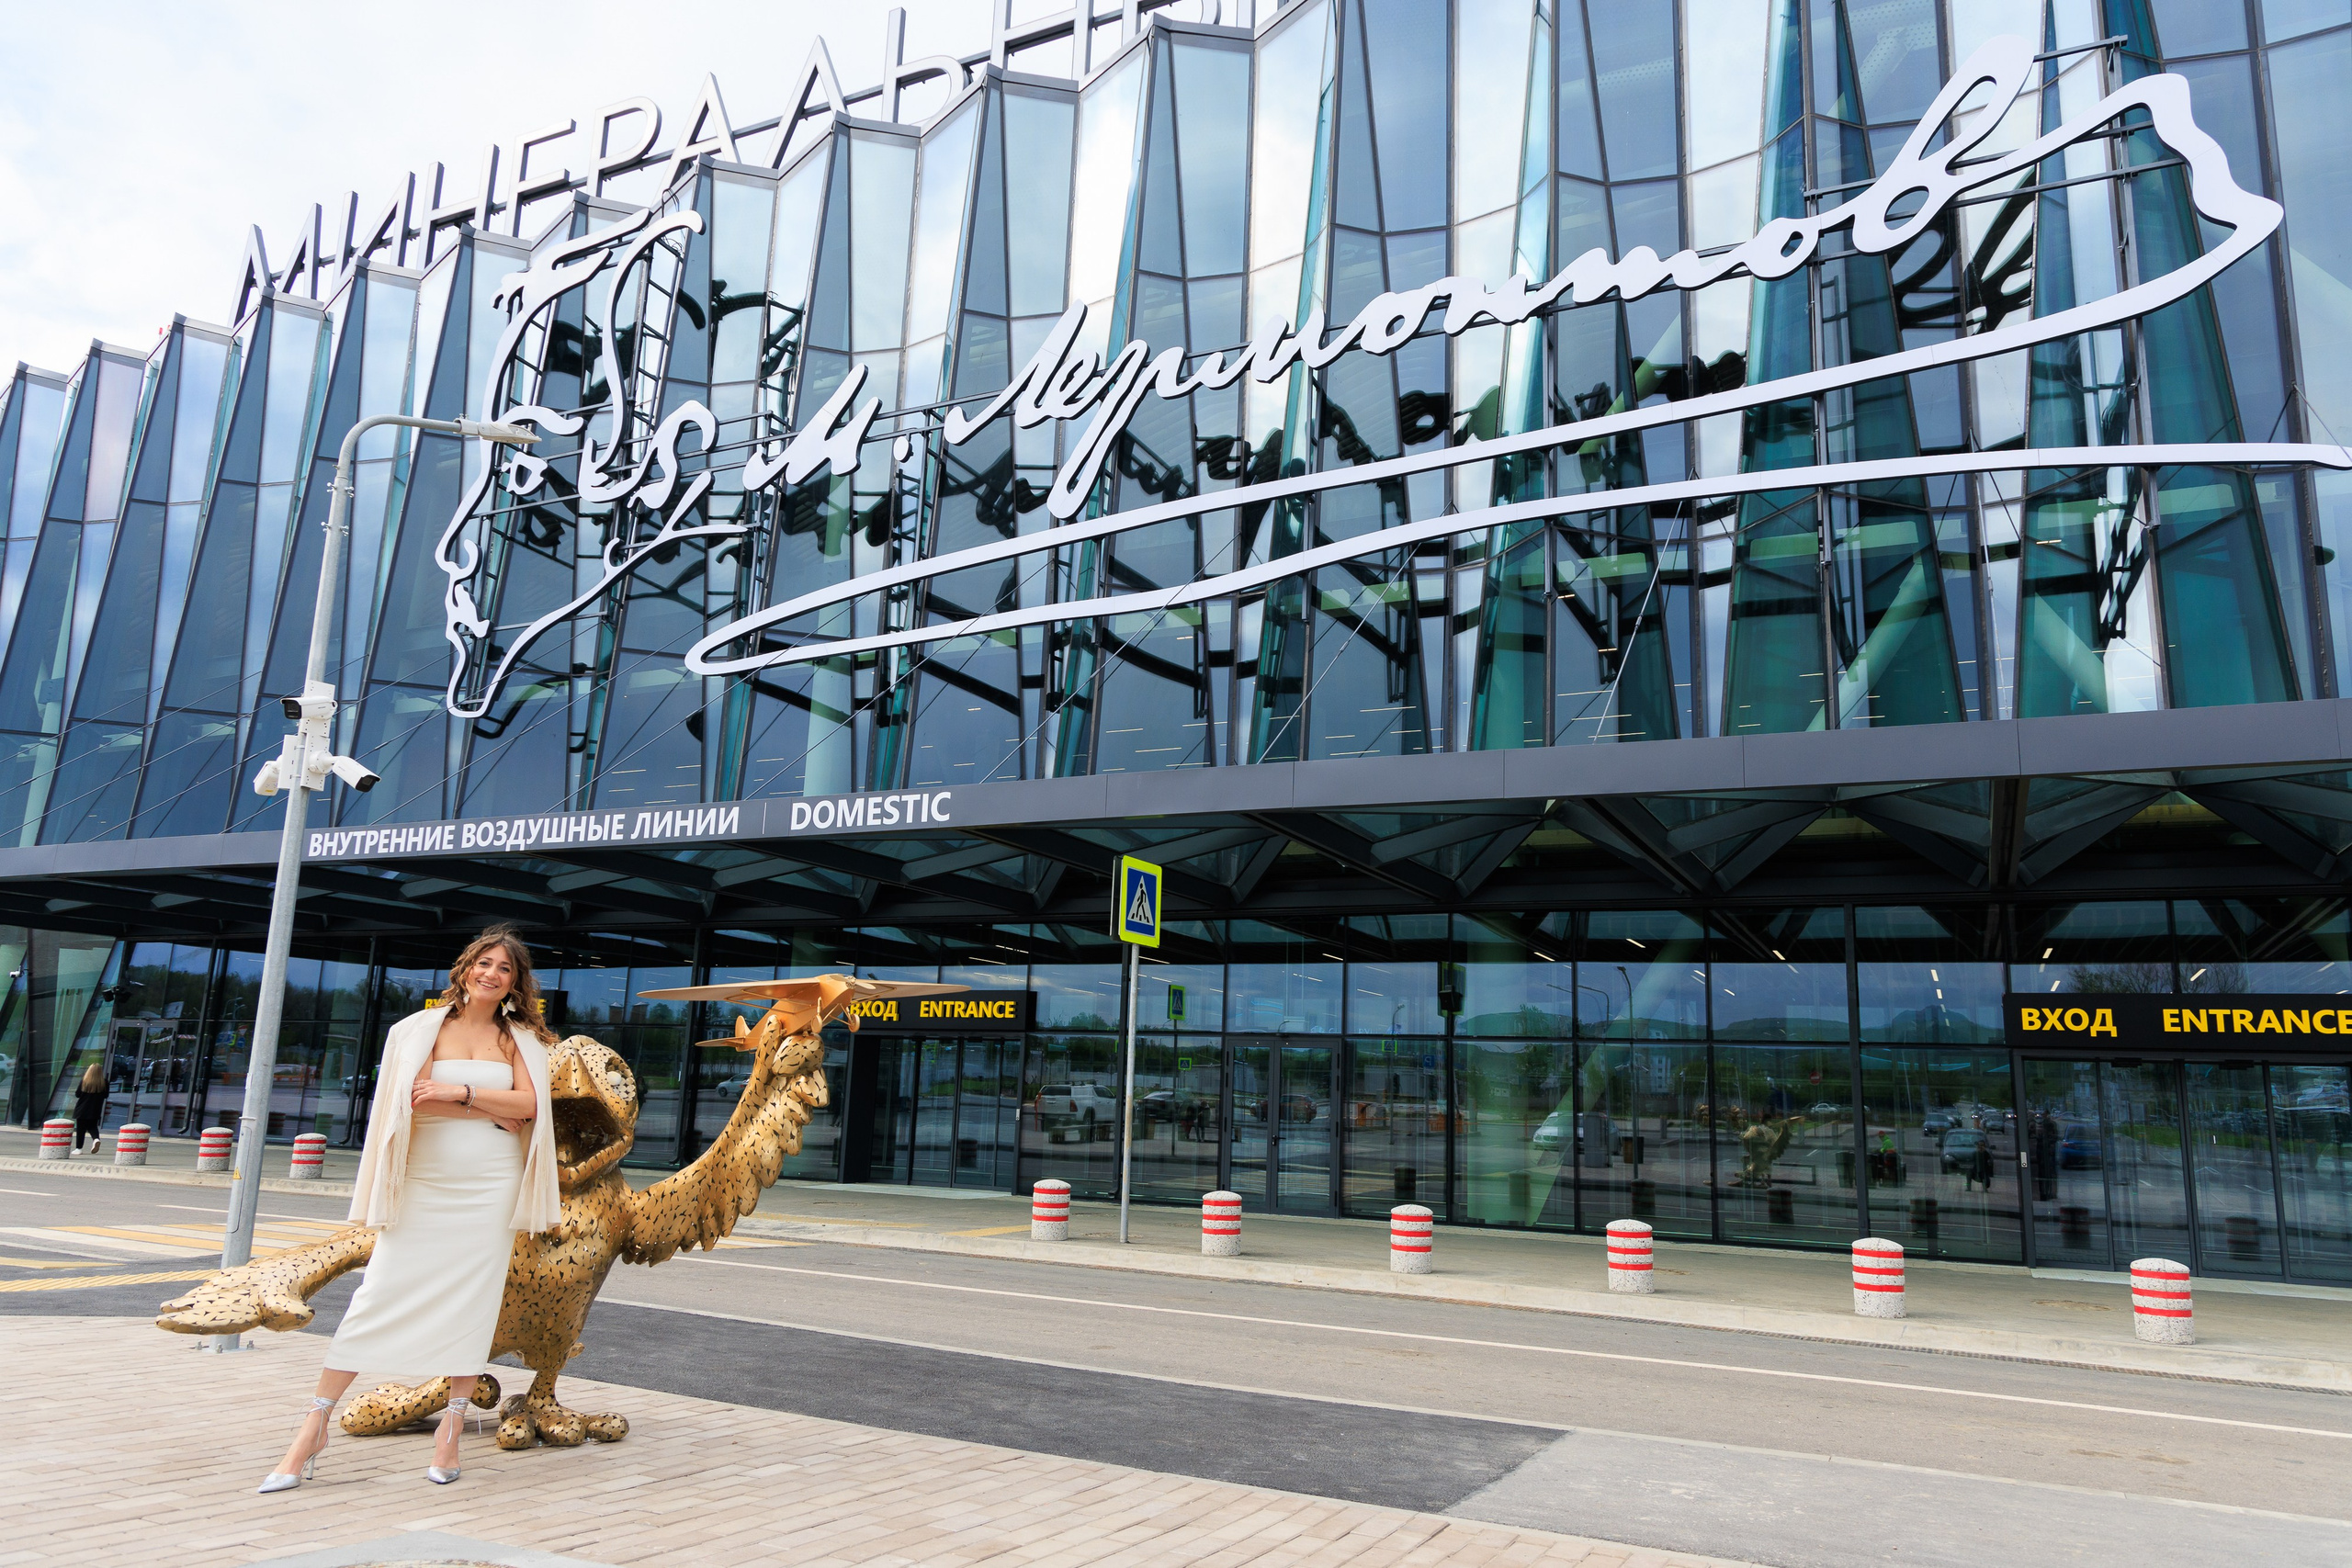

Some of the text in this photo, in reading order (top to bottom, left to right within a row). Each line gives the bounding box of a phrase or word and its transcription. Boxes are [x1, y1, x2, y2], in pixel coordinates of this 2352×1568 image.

[227, 0, 1297, 328] МИНЕРАЛЬН
[790, 791, 951, 831] DOMESTIC
[308, 807, 740, 857] ВНУТРЕННИЕ ВОЗДУШНЫЕ ЛИНИИ
[850, 1000, 899, 1021] ВХОД
[920, 1000, 1016, 1019] ENTRANCE
[2021, 1008, 2118, 1037] ВХОД
[2162, 1009, 2352, 1034] ENTRANCE
